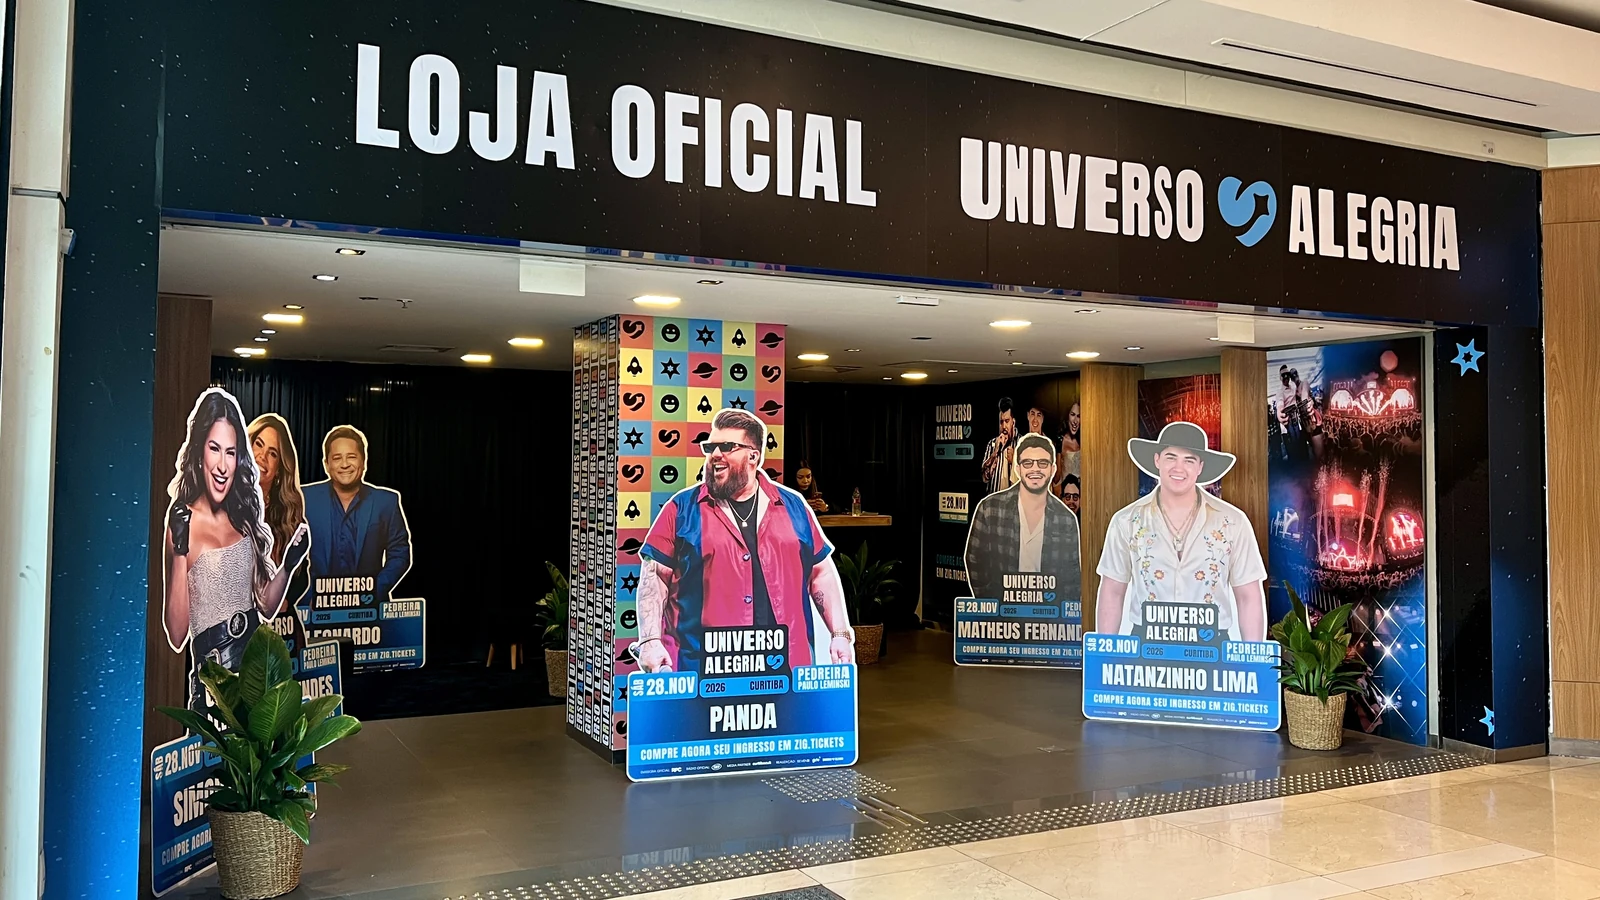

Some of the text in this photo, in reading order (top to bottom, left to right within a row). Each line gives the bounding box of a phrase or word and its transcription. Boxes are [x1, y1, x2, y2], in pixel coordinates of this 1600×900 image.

[356, 43, 877, 207] LOJA OFICIAL
[960, 137, 1460, 271] UNIVERSO ALEGRIA
[573, 372, 581, 440] ALEGRIA
[590, 366, 598, 439] ALEGRIA
[608, 366, 616, 439] ALEGRIA
[936, 404, 972, 423] UNIVERSO
[936, 425, 963, 440] ALEGRIA
[572, 443, 580, 518] UNIVERSO
[589, 442, 597, 520] UNIVERSO
[606, 442, 614, 522] UNIVERSO
[580, 459, 588, 528] ALEGRIA
[597, 459, 605, 531] ALEGRIA
[571, 527, 579, 597] ALEGRIA
[579, 532, 587, 609] UNIVERSO
[587, 530, 595, 602] ALEGRIA
[605, 533, 613, 608] ALEGRIA
[595, 534, 604, 615] UNIVERSO
[936, 567, 943, 578] EM
[1003, 574, 1056, 589] UNIVERSO
[315, 577, 374, 594] UNIVERSO
[315, 594, 360, 608] ALEGRIA
[1003, 590, 1043, 603] ALEGRIA
[383, 602, 420, 612] PEDREIRA
[966, 601, 997, 613] 28.NOV
[1146, 605, 1214, 625] UNIVERSO
[569, 600, 577, 676] UNIVERSO
[958, 621, 1020, 639] MATHEUS
[1146, 626, 1198, 642] ALEGRIA
[585, 605, 593, 684] UNIVERSO
[705, 629, 784, 653] UNIVERSO
[962, 645, 986, 653] COMPRE
[988, 646, 1007, 654] AGORA
[1021, 648, 1049, 656] INGRESSO
[1051, 648, 1060, 656] EM
[1086, 637, 1097, 651] SÁB
[1098, 638, 1138, 654] 28.NOV
[1146, 647, 1164, 655] 2026
[1226, 642, 1274, 655] PEDREIRA
[303, 645, 336, 661] PEDREIRA
[368, 651, 378, 659] EM
[380, 649, 416, 659] ZIG.TICKETS
[577, 620, 585, 692] ALEGRIA
[603, 610, 611, 693] UNIVERSO
[1184, 649, 1214, 658] CURITIBA
[1226, 654, 1245, 662] PAULO
[594, 627, 602, 700] ALEGRIA
[705, 654, 765, 674] ALEGRIA
[798, 666, 850, 680] PEDREIRA
[631, 679, 644, 696] SÁB
[646, 676, 695, 696] 28.NOV
[705, 683, 726, 692] 2026
[750, 680, 784, 690] CURITIBA
[798, 679, 850, 690] PAULO LEMINSKI
[1102, 664, 1258, 694] NATANZINHO LIMA
[1093, 694, 1268, 714] COMPRE AGORA SEU INGRESSO EM ZIG.TICKETS
[710, 702, 777, 732] PANDA
[165, 741, 201, 776] 28.NOV
[640, 736, 844, 761] COMPRE AGORA SEU INGRESSO EM ZIG.TICKETS
[154, 756, 163, 780] SÁB
[161, 838, 190, 865] COMPRE
